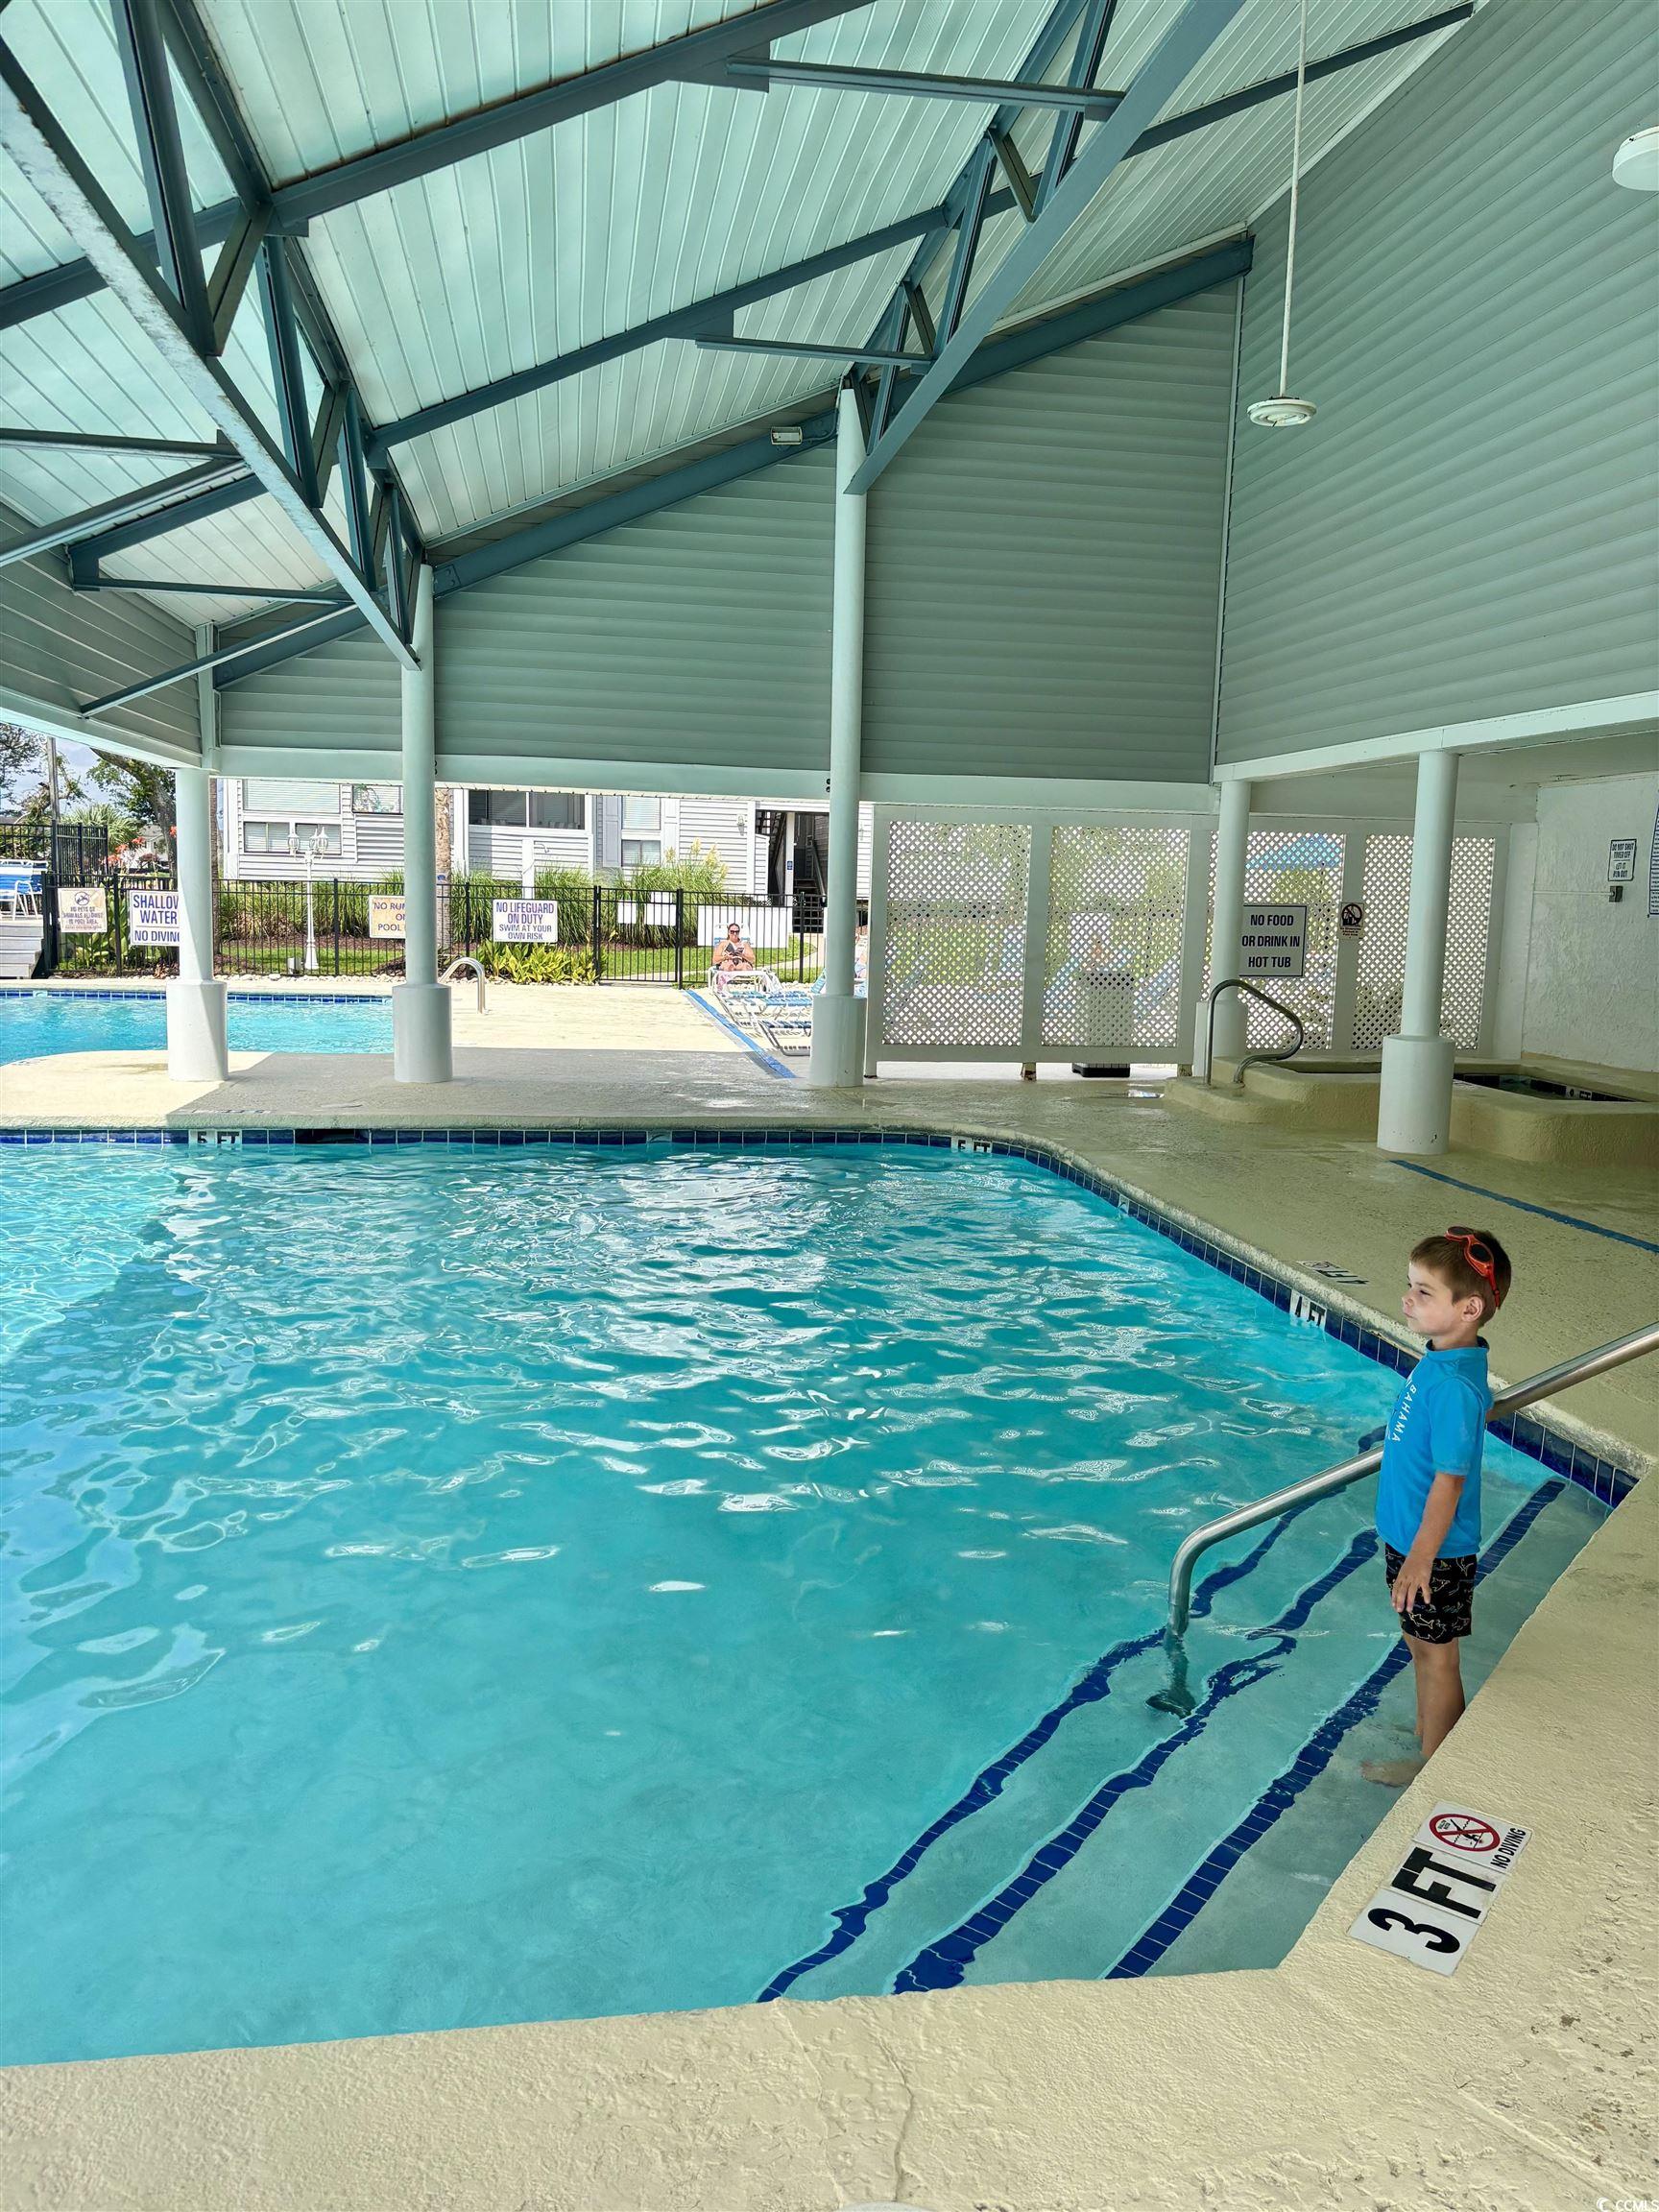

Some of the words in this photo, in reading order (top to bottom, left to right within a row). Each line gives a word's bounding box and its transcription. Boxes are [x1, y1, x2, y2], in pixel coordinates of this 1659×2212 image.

[496, 902, 508, 913] NO
[510, 902, 554, 914] LIFEGUARD
[140, 909, 177, 925] WATER
[508, 913, 519, 924] ON
[521, 914, 542, 925] DUTY
[1250, 915, 1265, 926] NO
[1267, 915, 1294, 926] FOOD
[499, 924, 520, 932] SWIM
[134, 930, 148, 941] NO
[1241, 935, 1256, 947] OR
[1257, 935, 1287, 947] DRINK
[1289, 935, 1300, 947] IN
[1248, 956, 1269, 968] HOT
[1271, 956, 1291, 968] TUB
[217, 1131, 240, 1143] FT
[1307, 1302, 1326, 1327] FT
[1392, 1384, 1417, 1442] BAHAMA
[1490, 1854, 1511, 1869] NO
[1503, 1827, 1527, 1857] DIVING
[1391, 1846, 1497, 1919] FT
[1367, 1908, 1460, 1954] 3
